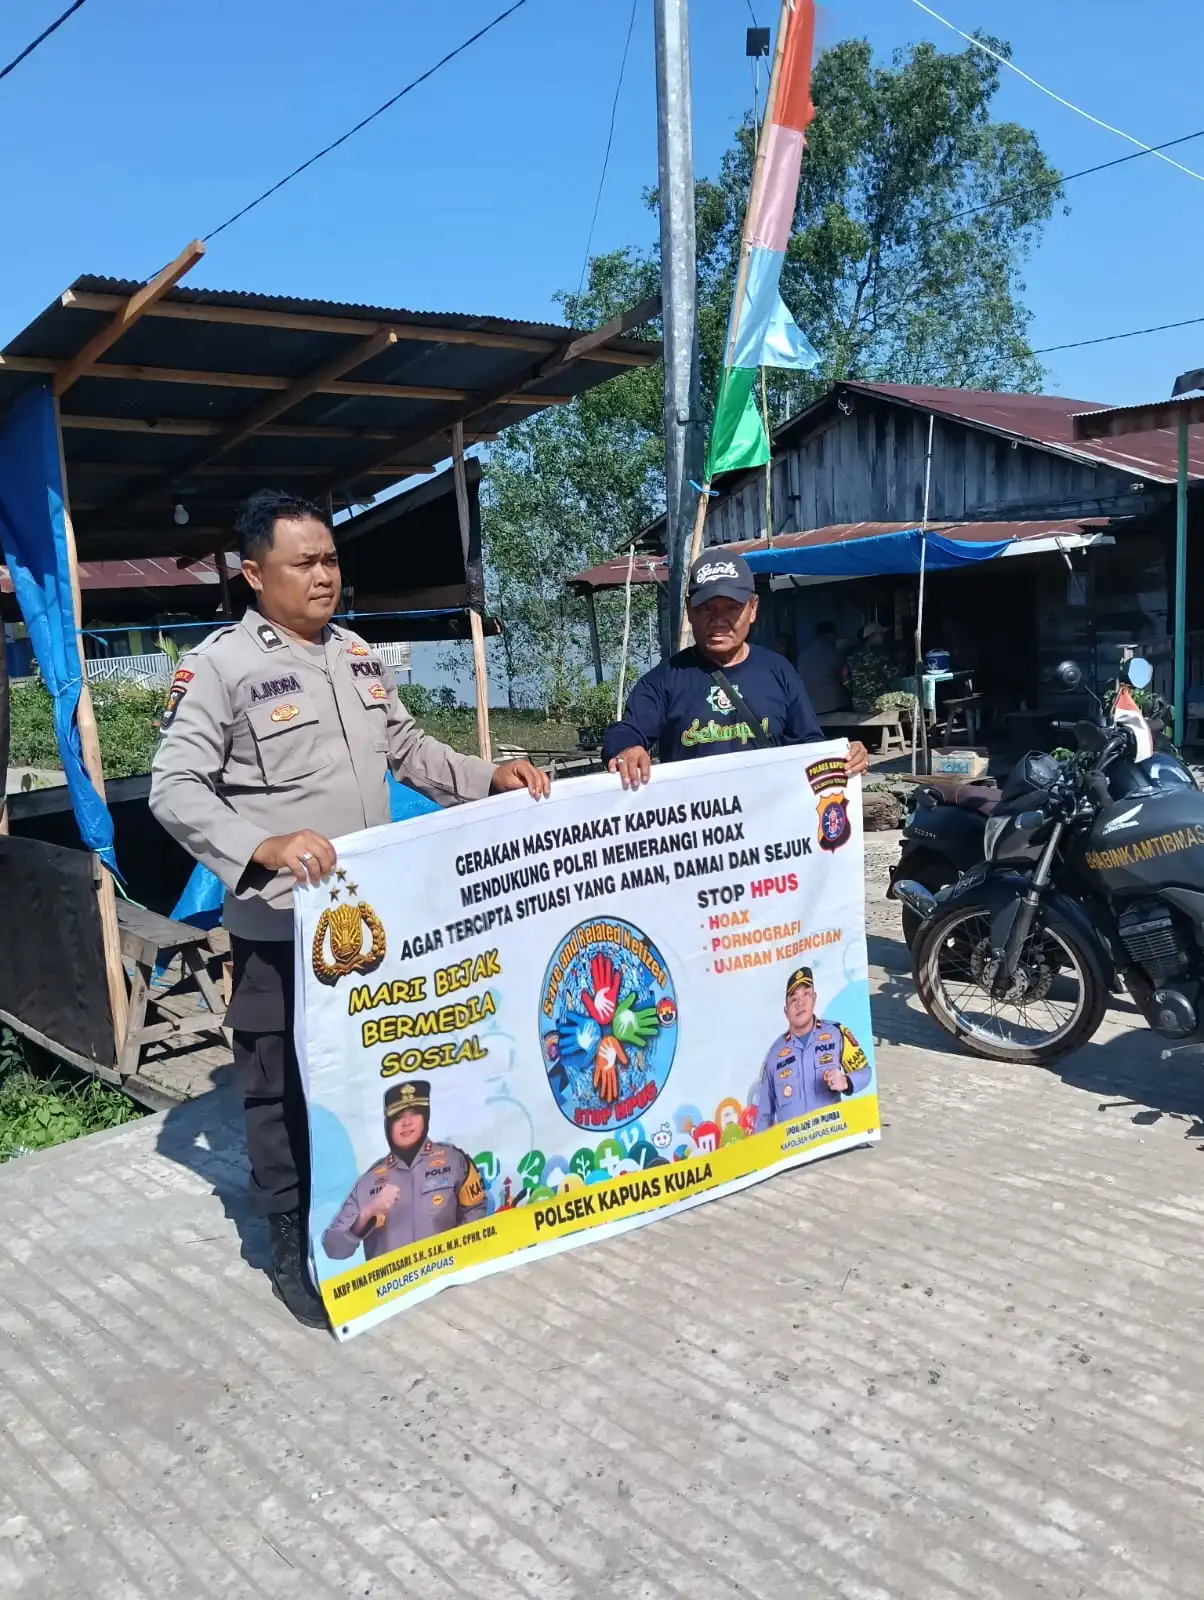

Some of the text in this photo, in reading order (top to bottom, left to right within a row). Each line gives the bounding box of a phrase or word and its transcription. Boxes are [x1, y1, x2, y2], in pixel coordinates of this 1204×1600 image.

[455, 795, 742, 876] GERAKAN MASYARAKAT KAPUAS KUALA
[460, 822, 744, 907] MENDUKUNG POLRI MEMERANGI HOAX
[400, 837, 813, 961] AGAR TERCIPTA SITUASI YANG AMAN, DAMAI DAN SEJUK
[697, 873, 798, 908] STOP HPUS
[708, 909, 750, 930] HOAX
[712, 920, 801, 951] PORNOGRAFI
[543, 922, 668, 1019] Save and Related Netizen
[714, 929, 842, 974] UJARAN KEBENCIAN
[349, 948, 501, 1016] MARI BIJAK
[362, 991, 496, 1048] BERMEDIA
[380, 1035, 489, 1078] SOSIAL
[830, 1122, 848, 1132] KUALA
[424, 1166, 451, 1178] POLRI
[534, 1163, 713, 1231] POLSEK KAPUAS KUALA
[333, 1282, 351, 1300] AKBP
[352, 1275, 368, 1291] RINA
[376, 1256, 454, 1297] KAPOLRES KAPUAS
